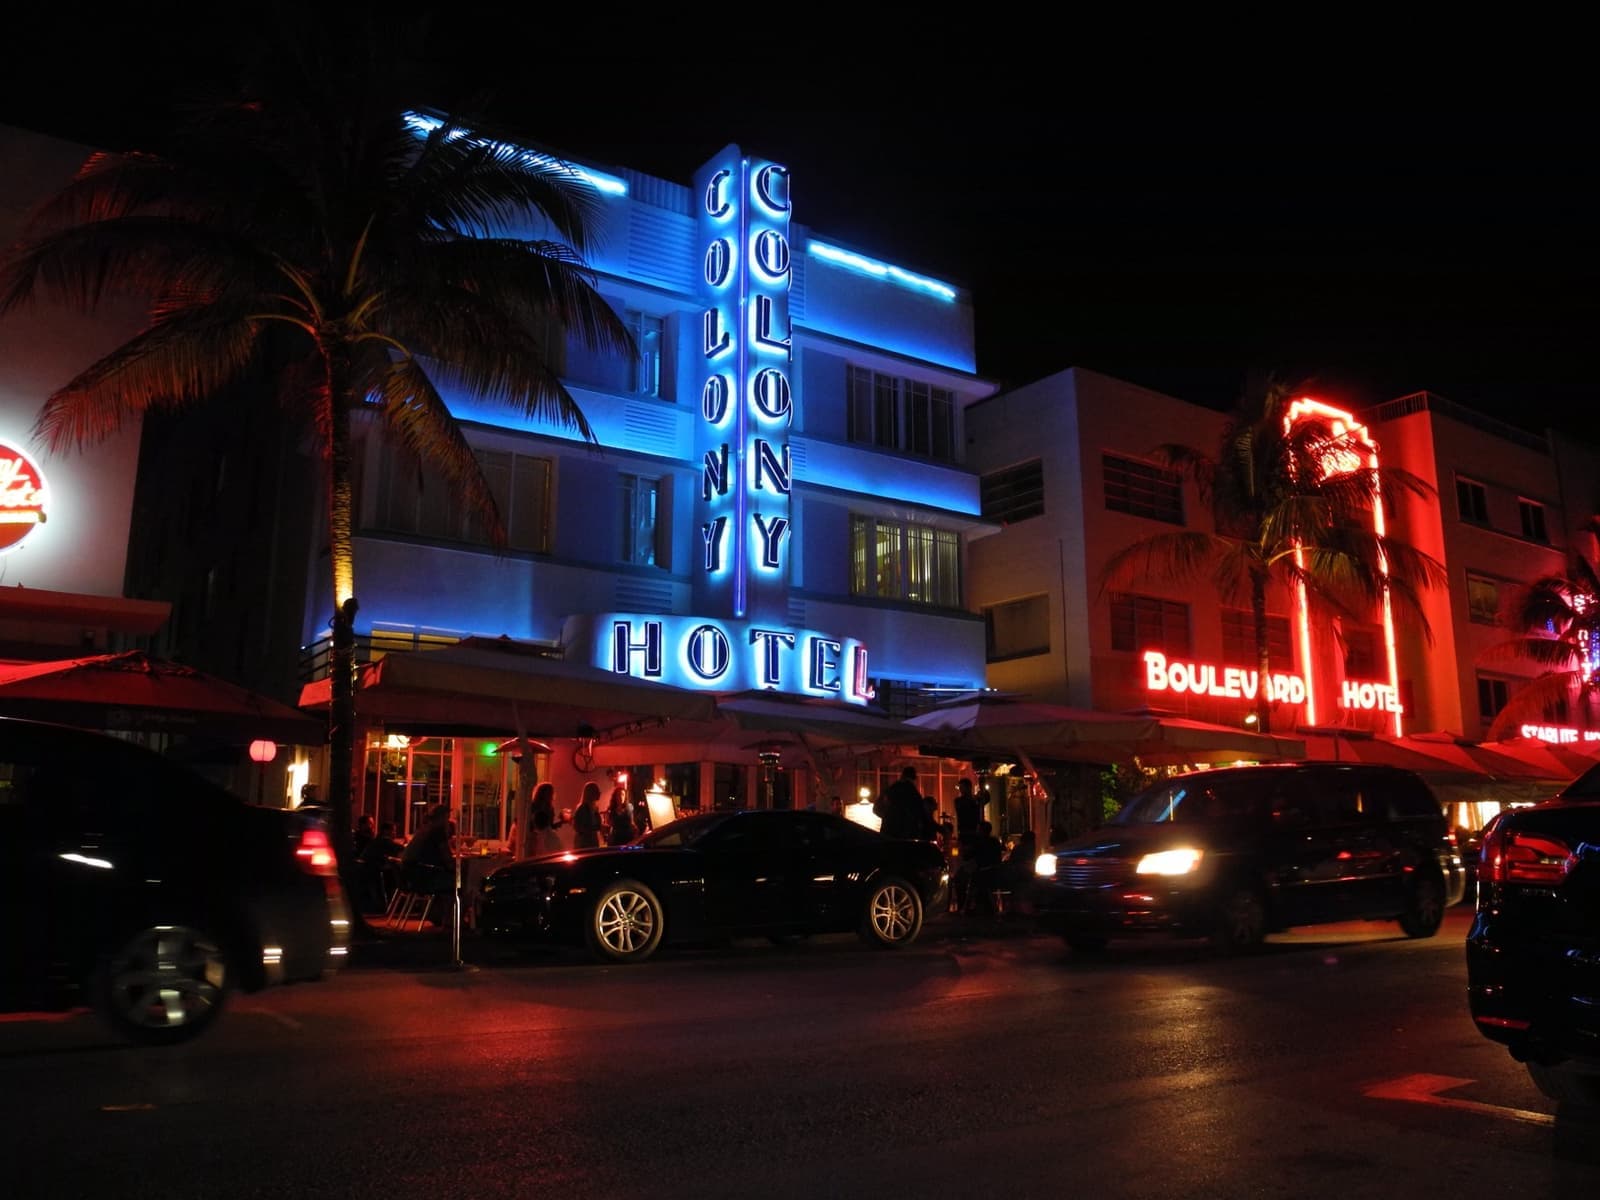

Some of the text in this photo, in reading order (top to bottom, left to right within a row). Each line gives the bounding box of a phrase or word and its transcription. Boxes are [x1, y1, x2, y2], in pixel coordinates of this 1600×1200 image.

[701, 169, 730, 572] COLONY
[753, 164, 792, 569] COLONY
[612, 620, 875, 700] HOTEL
[1342, 680, 1404, 714] HOTEL
